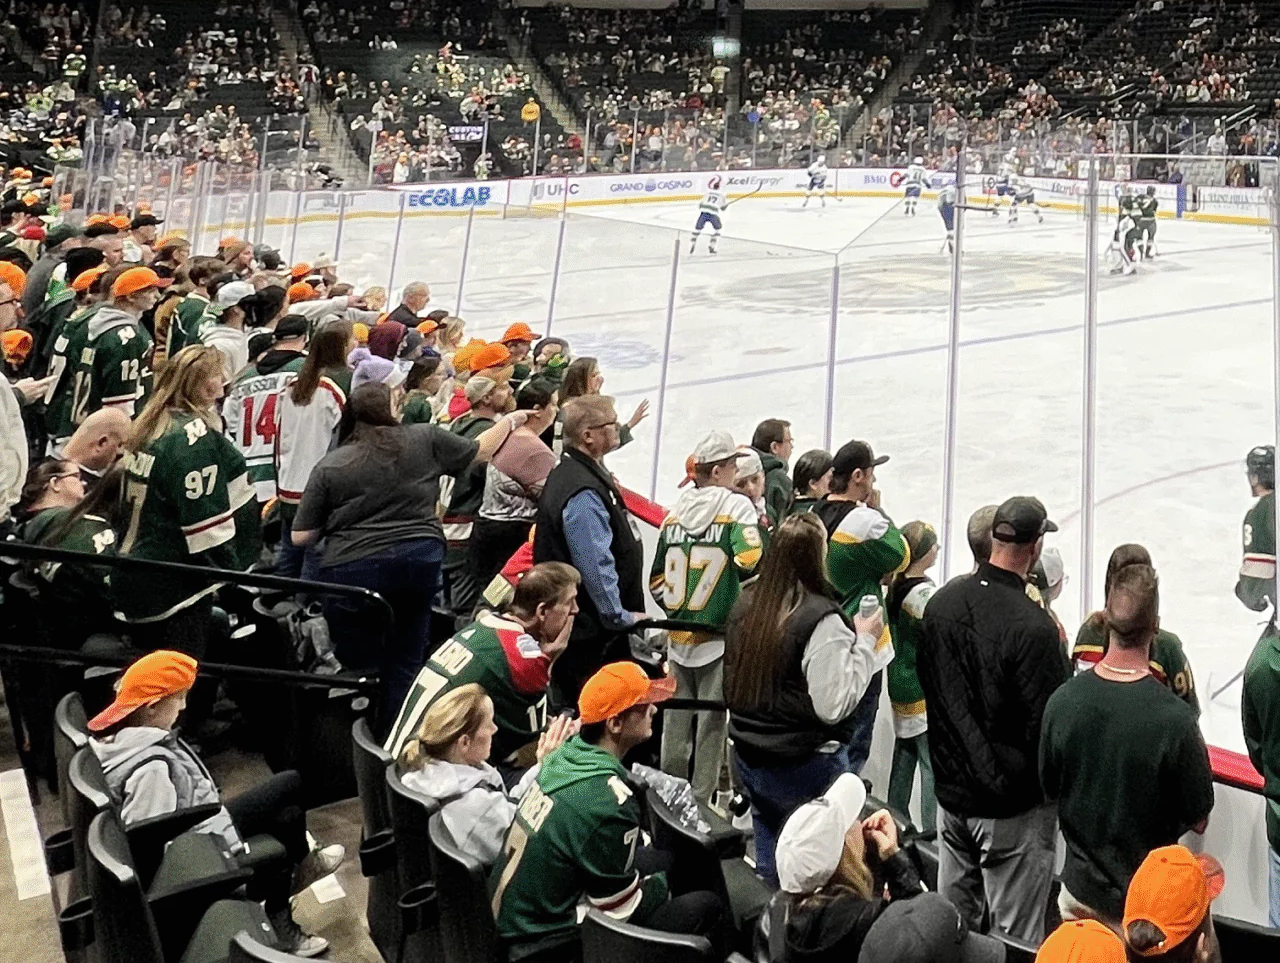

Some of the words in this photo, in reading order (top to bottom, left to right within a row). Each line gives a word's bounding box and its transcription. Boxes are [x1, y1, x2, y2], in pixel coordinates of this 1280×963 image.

[547, 183, 580, 196] UHC
[610, 182, 644, 192] GRAND
[657, 180, 693, 191] CASINO
[726, 176, 750, 186] Xcel
[750, 175, 784, 187] Energy
[864, 174, 887, 185] BMO
[409, 187, 491, 208] ECOLAB
[121, 358, 139, 381] 12
[242, 394, 279, 447] 14
[185, 464, 218, 500] 97
[663, 545, 729, 611] 97
